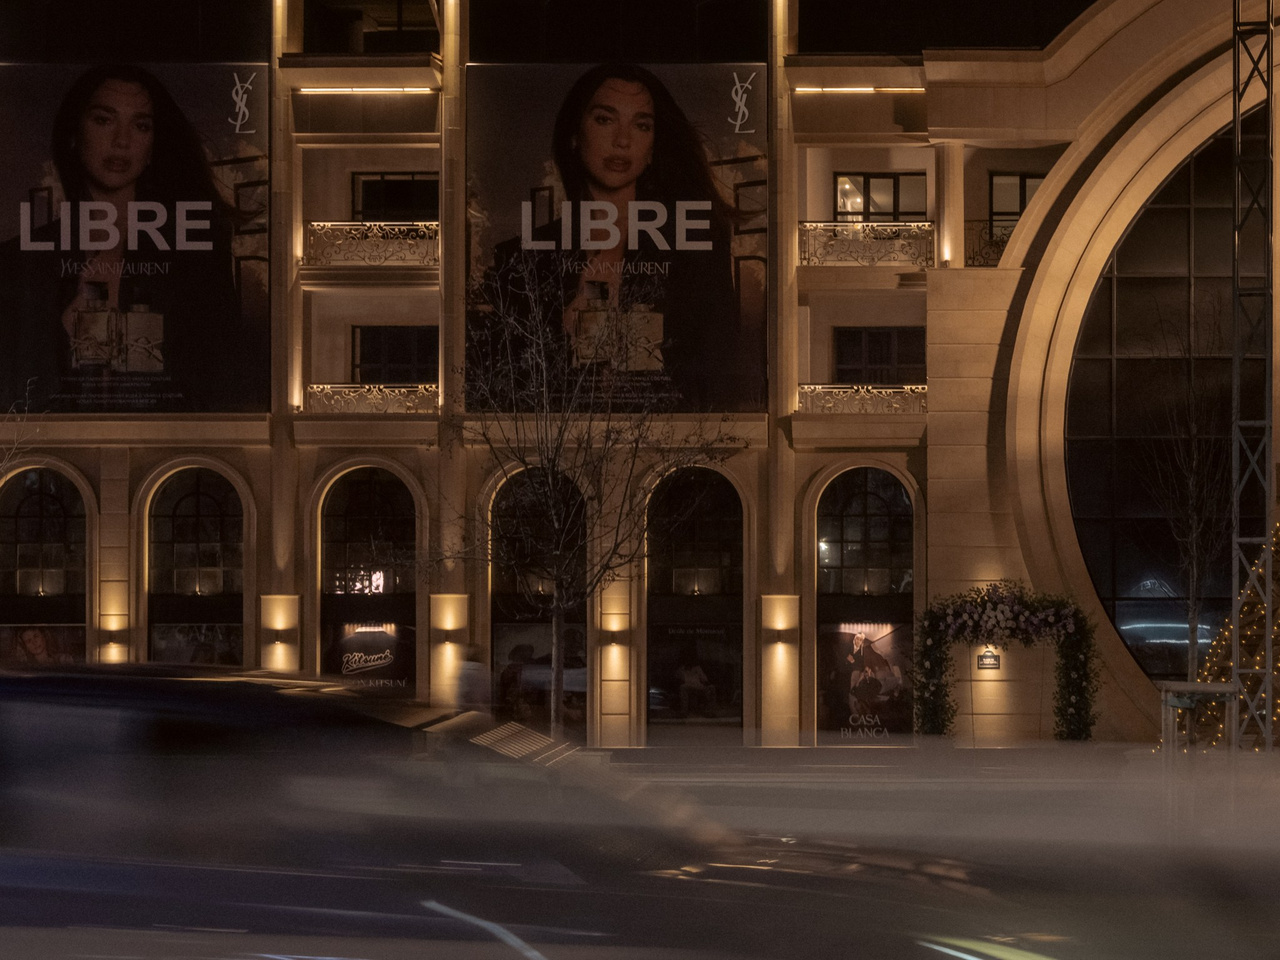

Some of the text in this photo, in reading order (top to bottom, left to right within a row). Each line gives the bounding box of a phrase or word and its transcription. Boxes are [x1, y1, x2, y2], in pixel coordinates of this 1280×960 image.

[20, 201, 214, 250] LIBRE
[521, 200, 713, 250] LIBRE
[840, 727, 890, 739] BLANCA
[848, 713, 881, 726] CASA
